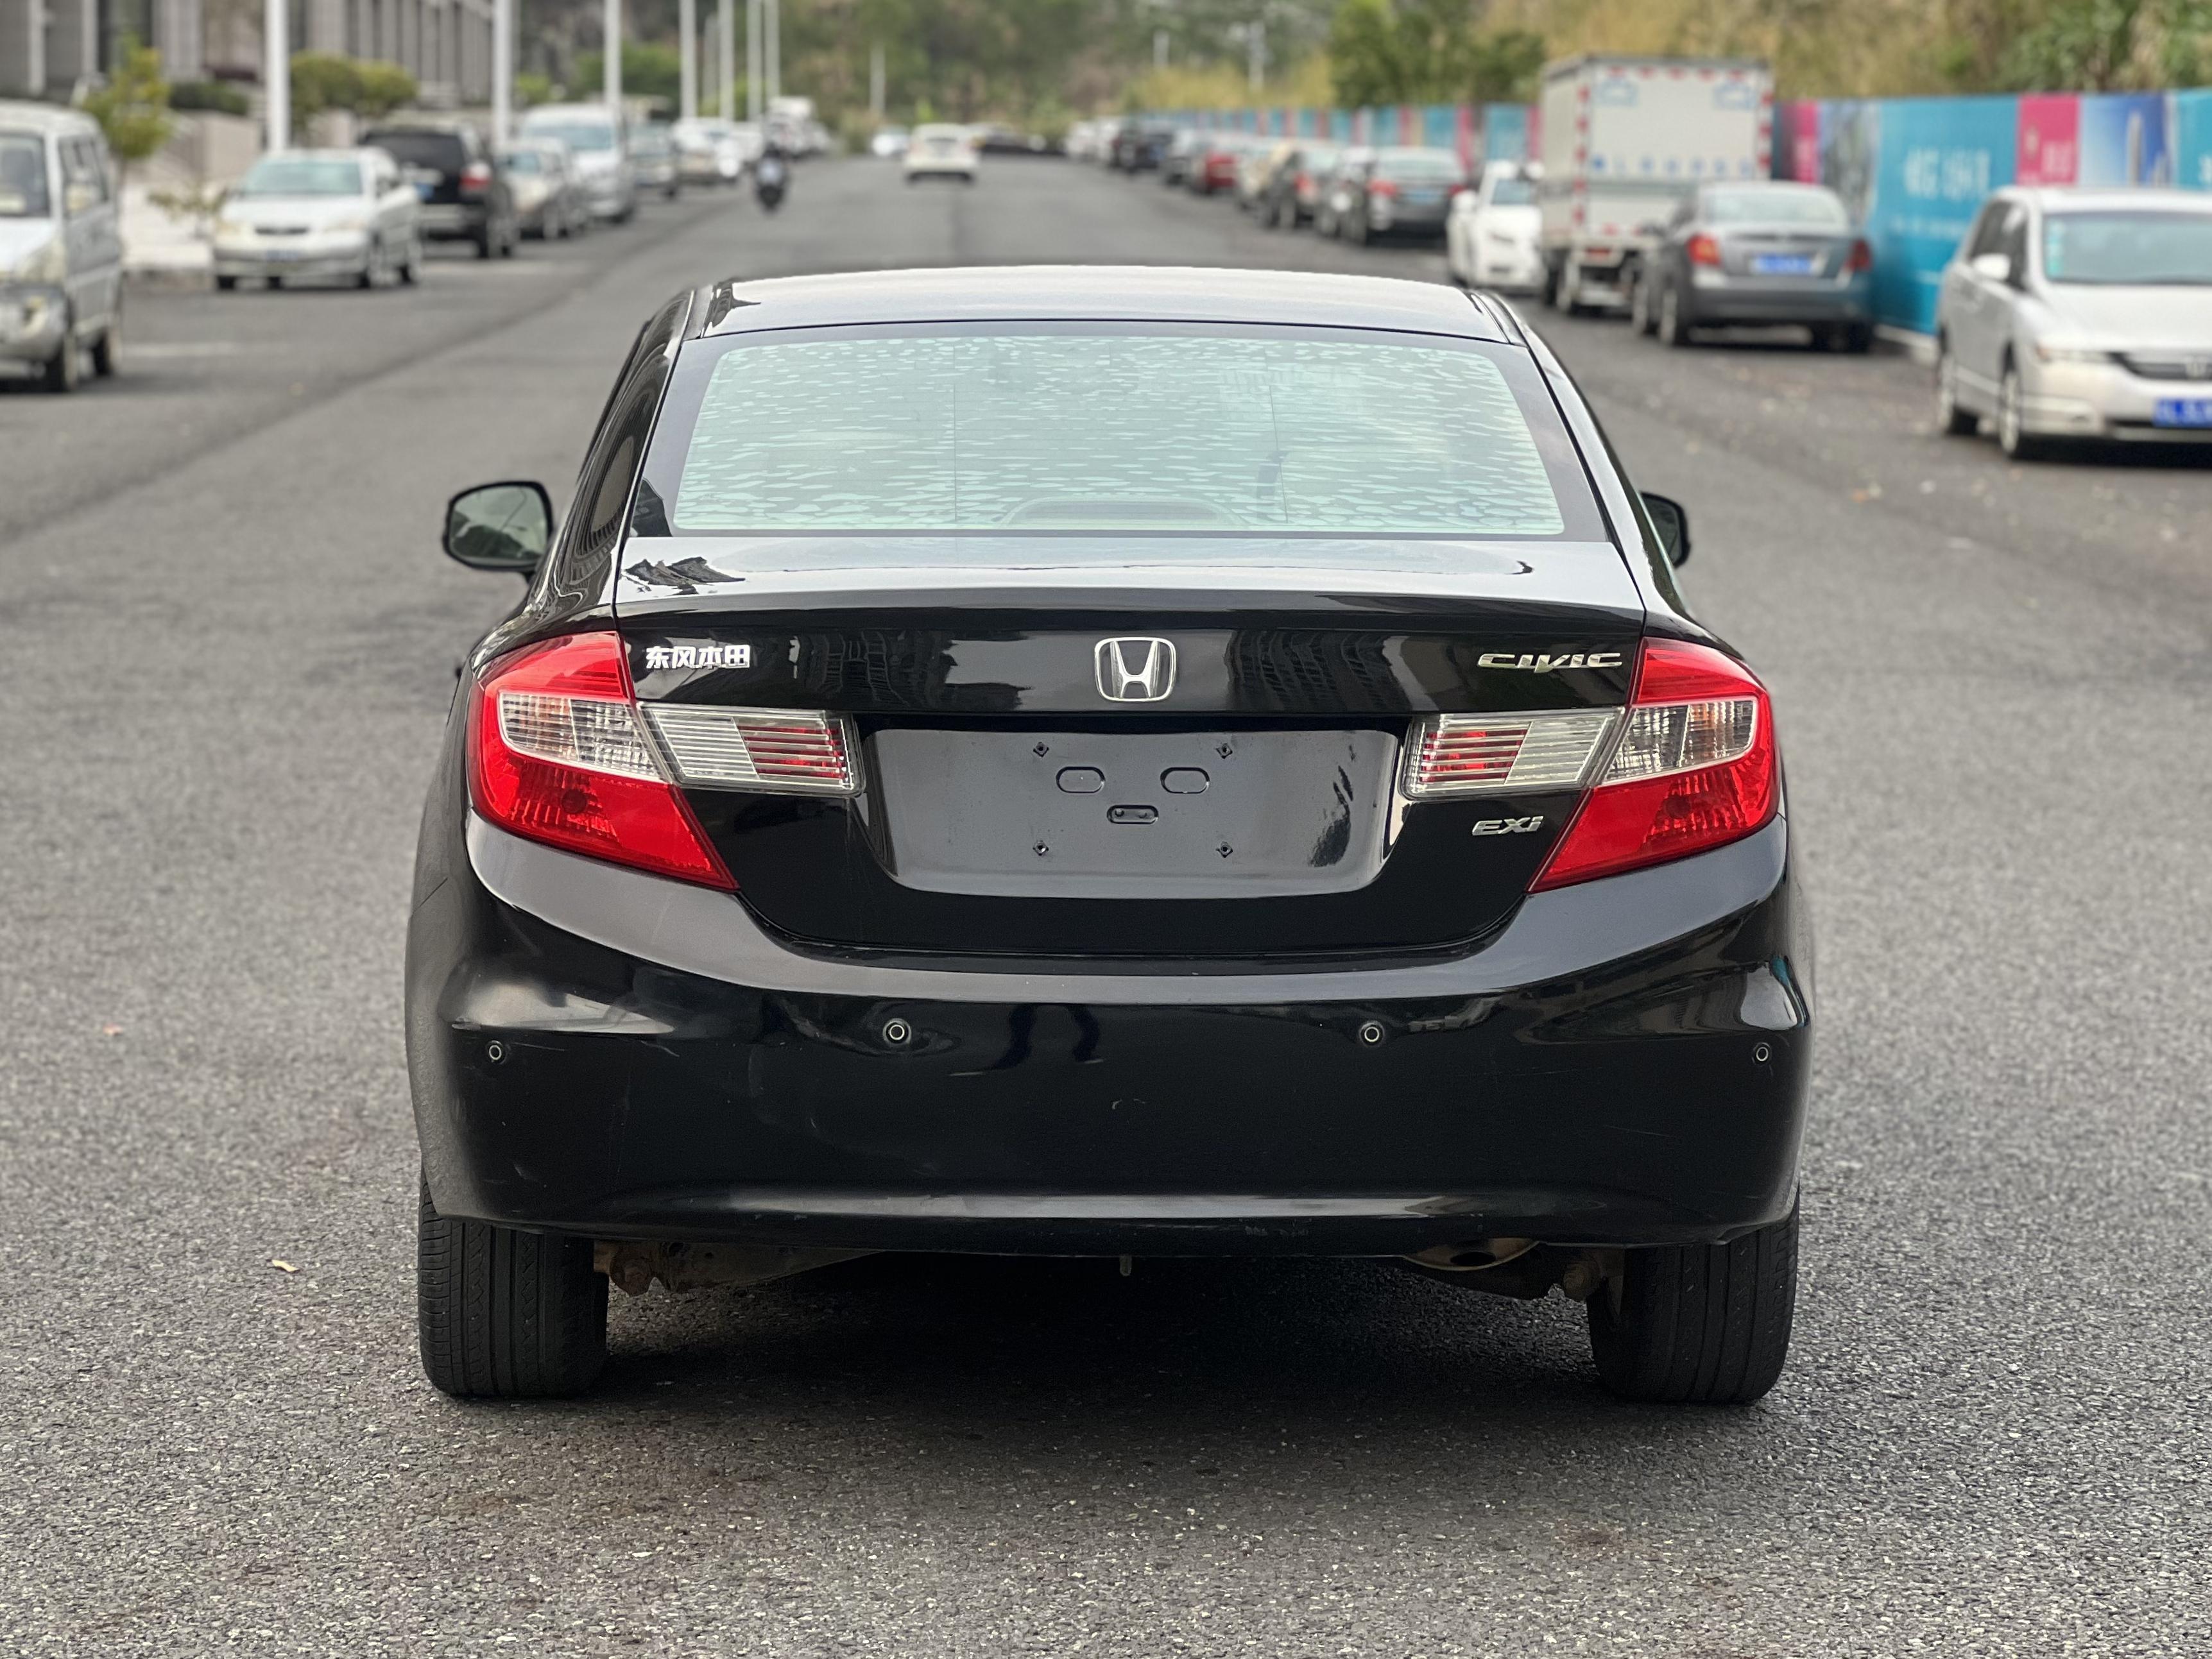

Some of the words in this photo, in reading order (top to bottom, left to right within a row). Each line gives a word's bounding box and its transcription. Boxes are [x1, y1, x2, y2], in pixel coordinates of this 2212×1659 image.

[646, 645, 750, 669] 东风本田
[1478, 653, 1622, 673] CIVIC
